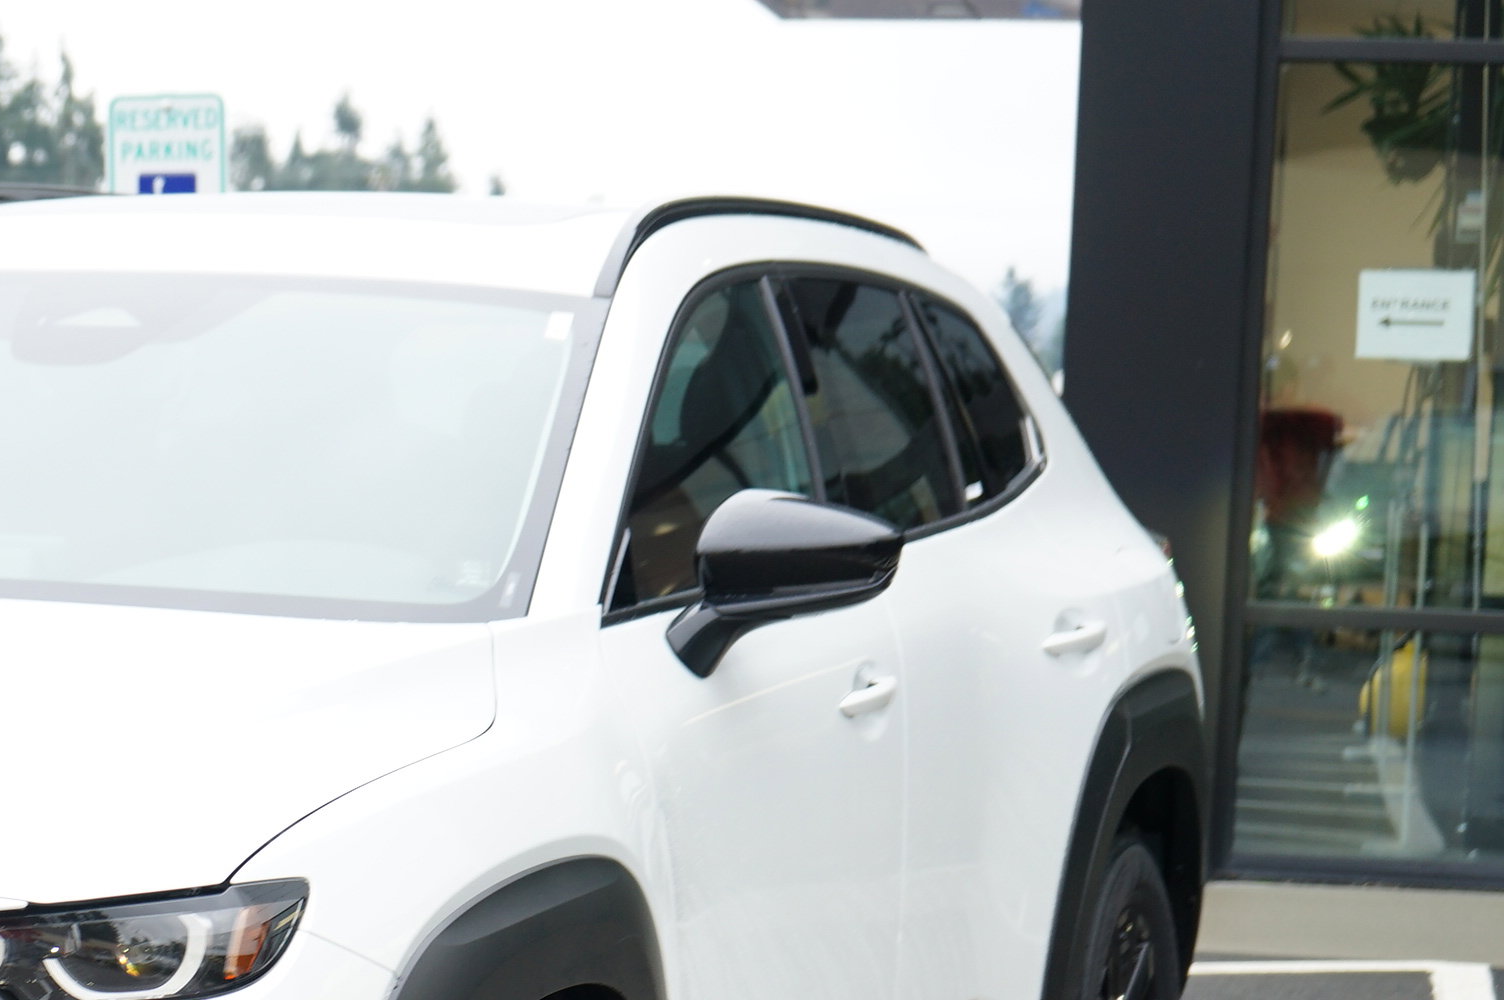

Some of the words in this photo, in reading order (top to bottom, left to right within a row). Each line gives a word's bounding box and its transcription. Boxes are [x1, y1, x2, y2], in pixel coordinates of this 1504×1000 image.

[115, 108, 218, 131] RESERVED
[121, 140, 213, 162] PARKING
[1370, 297, 1450, 312] ENTRANCE
